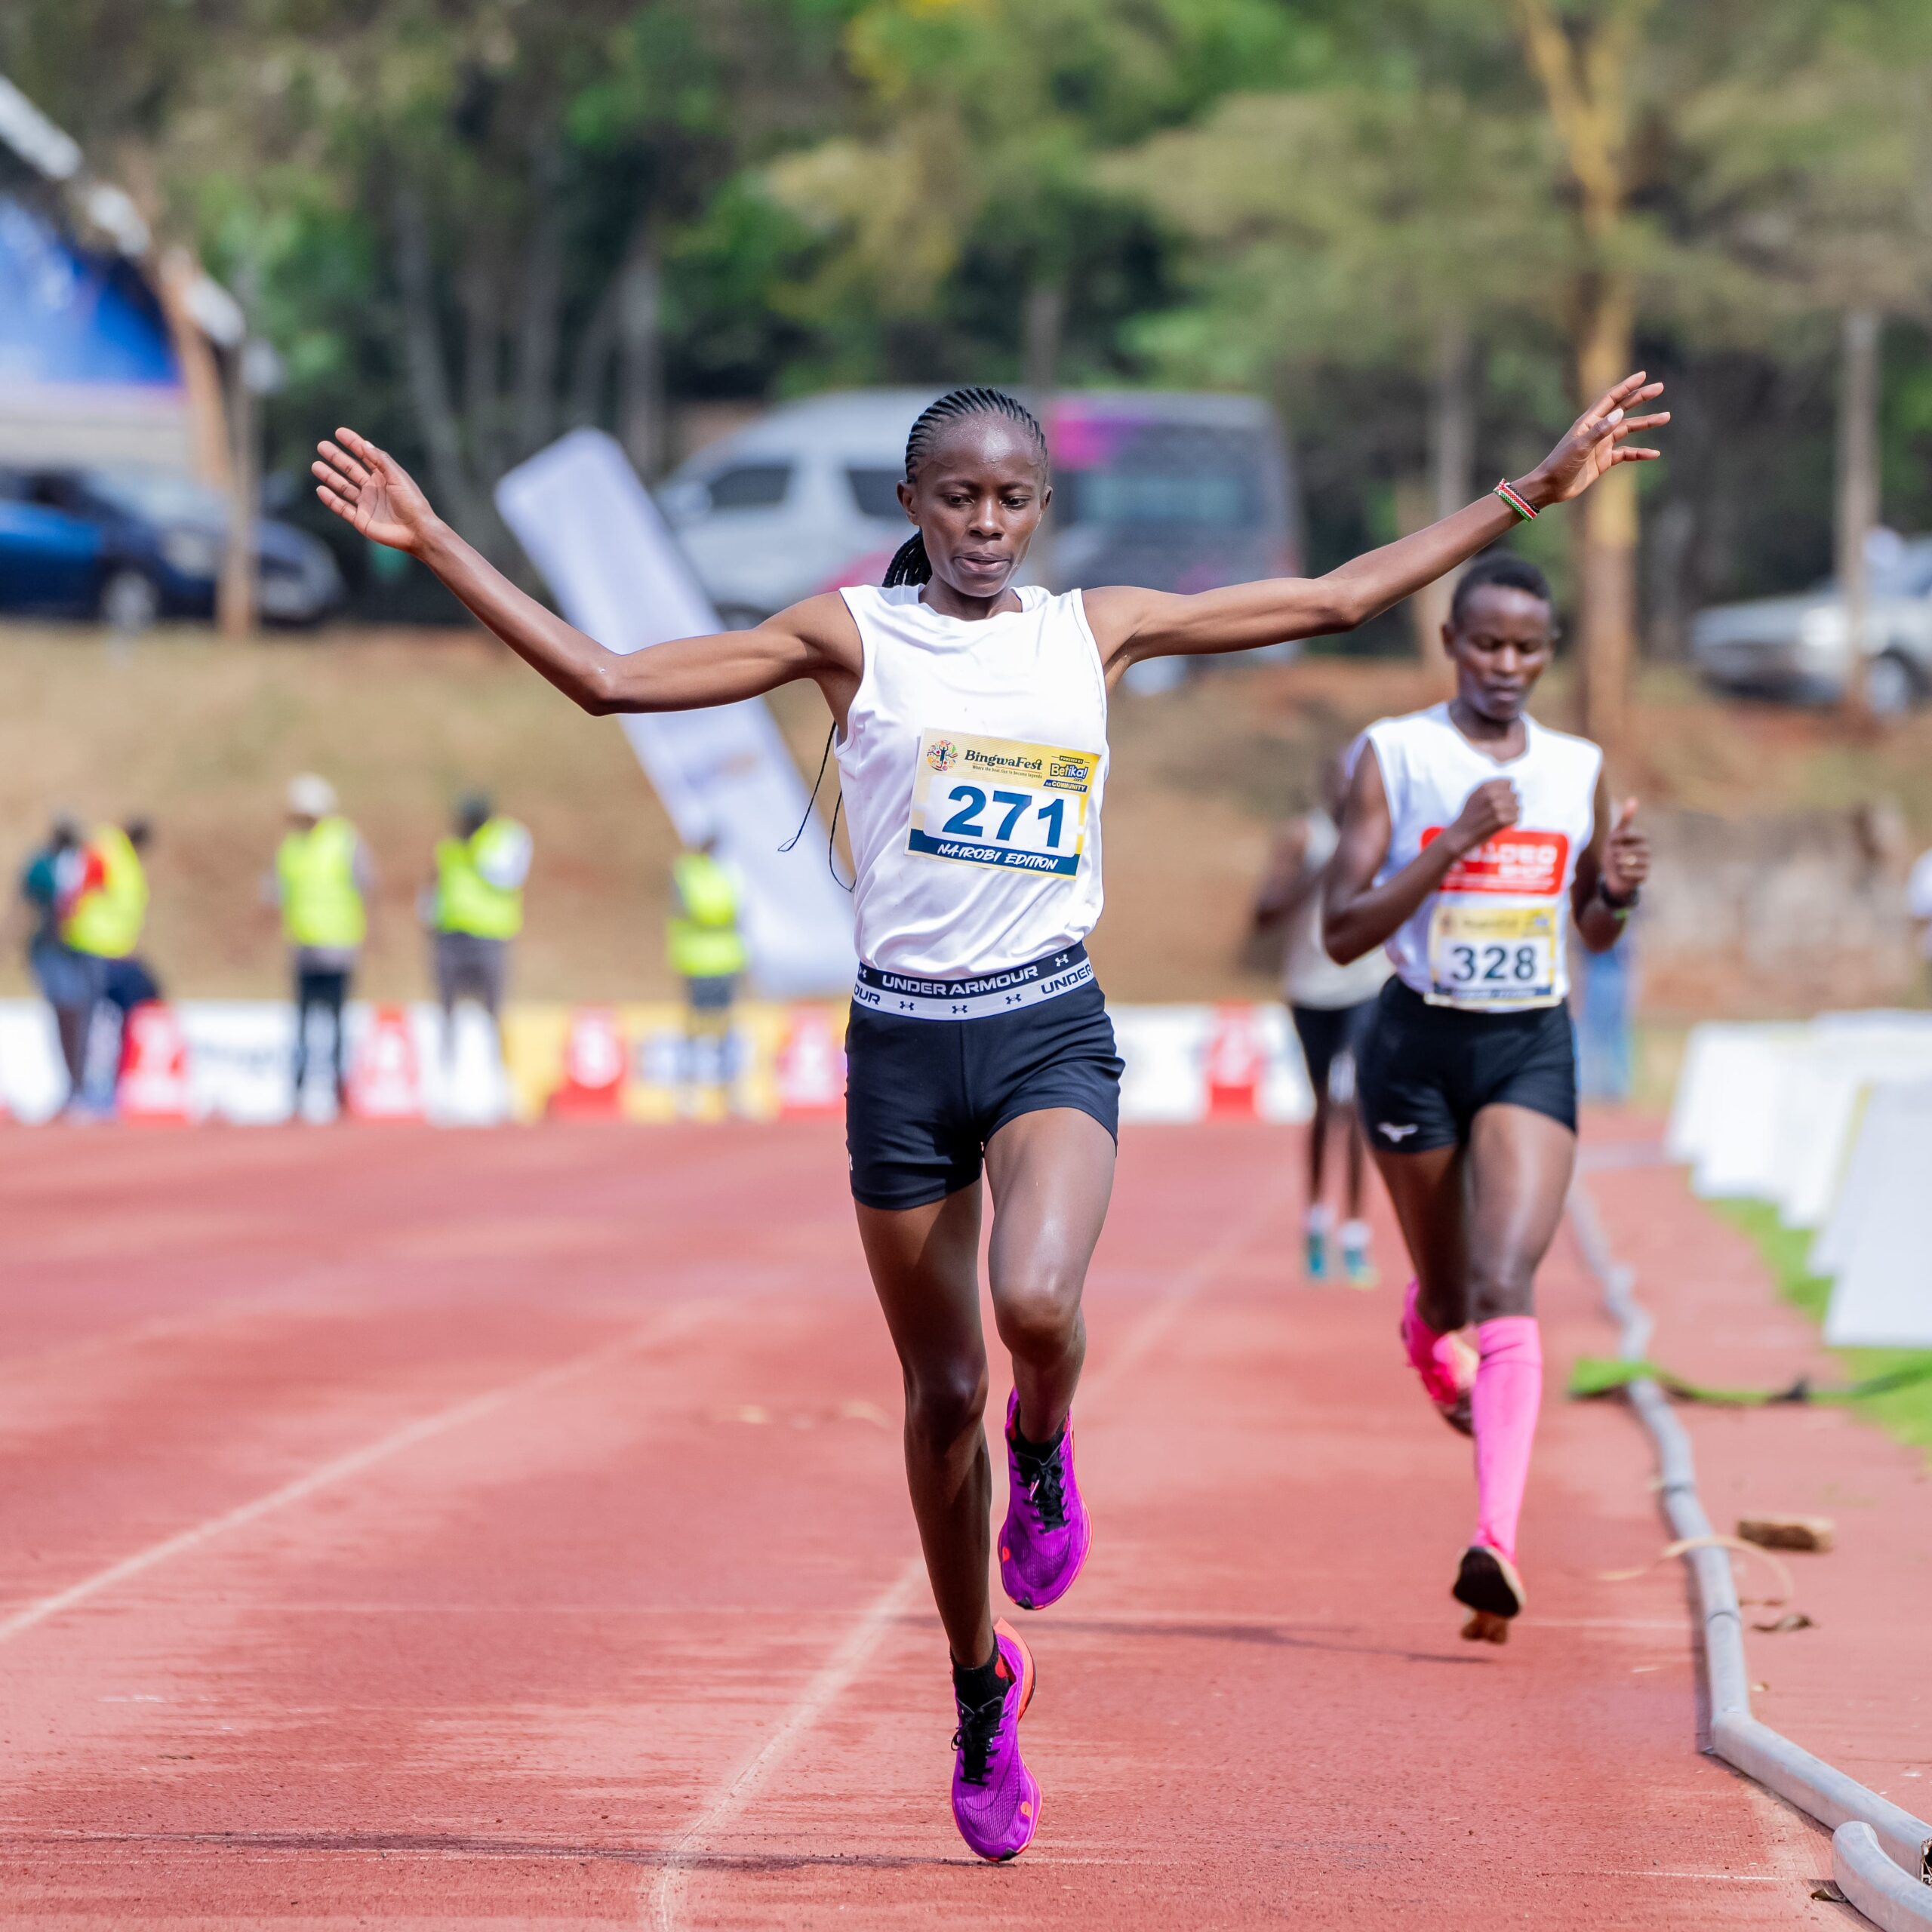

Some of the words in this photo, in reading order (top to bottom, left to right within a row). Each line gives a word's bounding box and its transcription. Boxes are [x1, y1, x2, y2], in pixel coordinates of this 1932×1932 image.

[964, 749, 1042, 770] BingwaFest
[1051, 763, 1088, 779] Betika!
[1051, 781, 1086, 791] COMMUNITY
[942, 785, 1064, 848] 271
[937, 843, 1001, 862] NAIROBI
[1004, 853, 1059, 870] EDITION
[1451, 946, 1536, 981] 328
[882, 974, 946, 995] UNDER
[949, 965, 1038, 995] ARMOUR
[1041, 964, 1092, 995] UNDER
